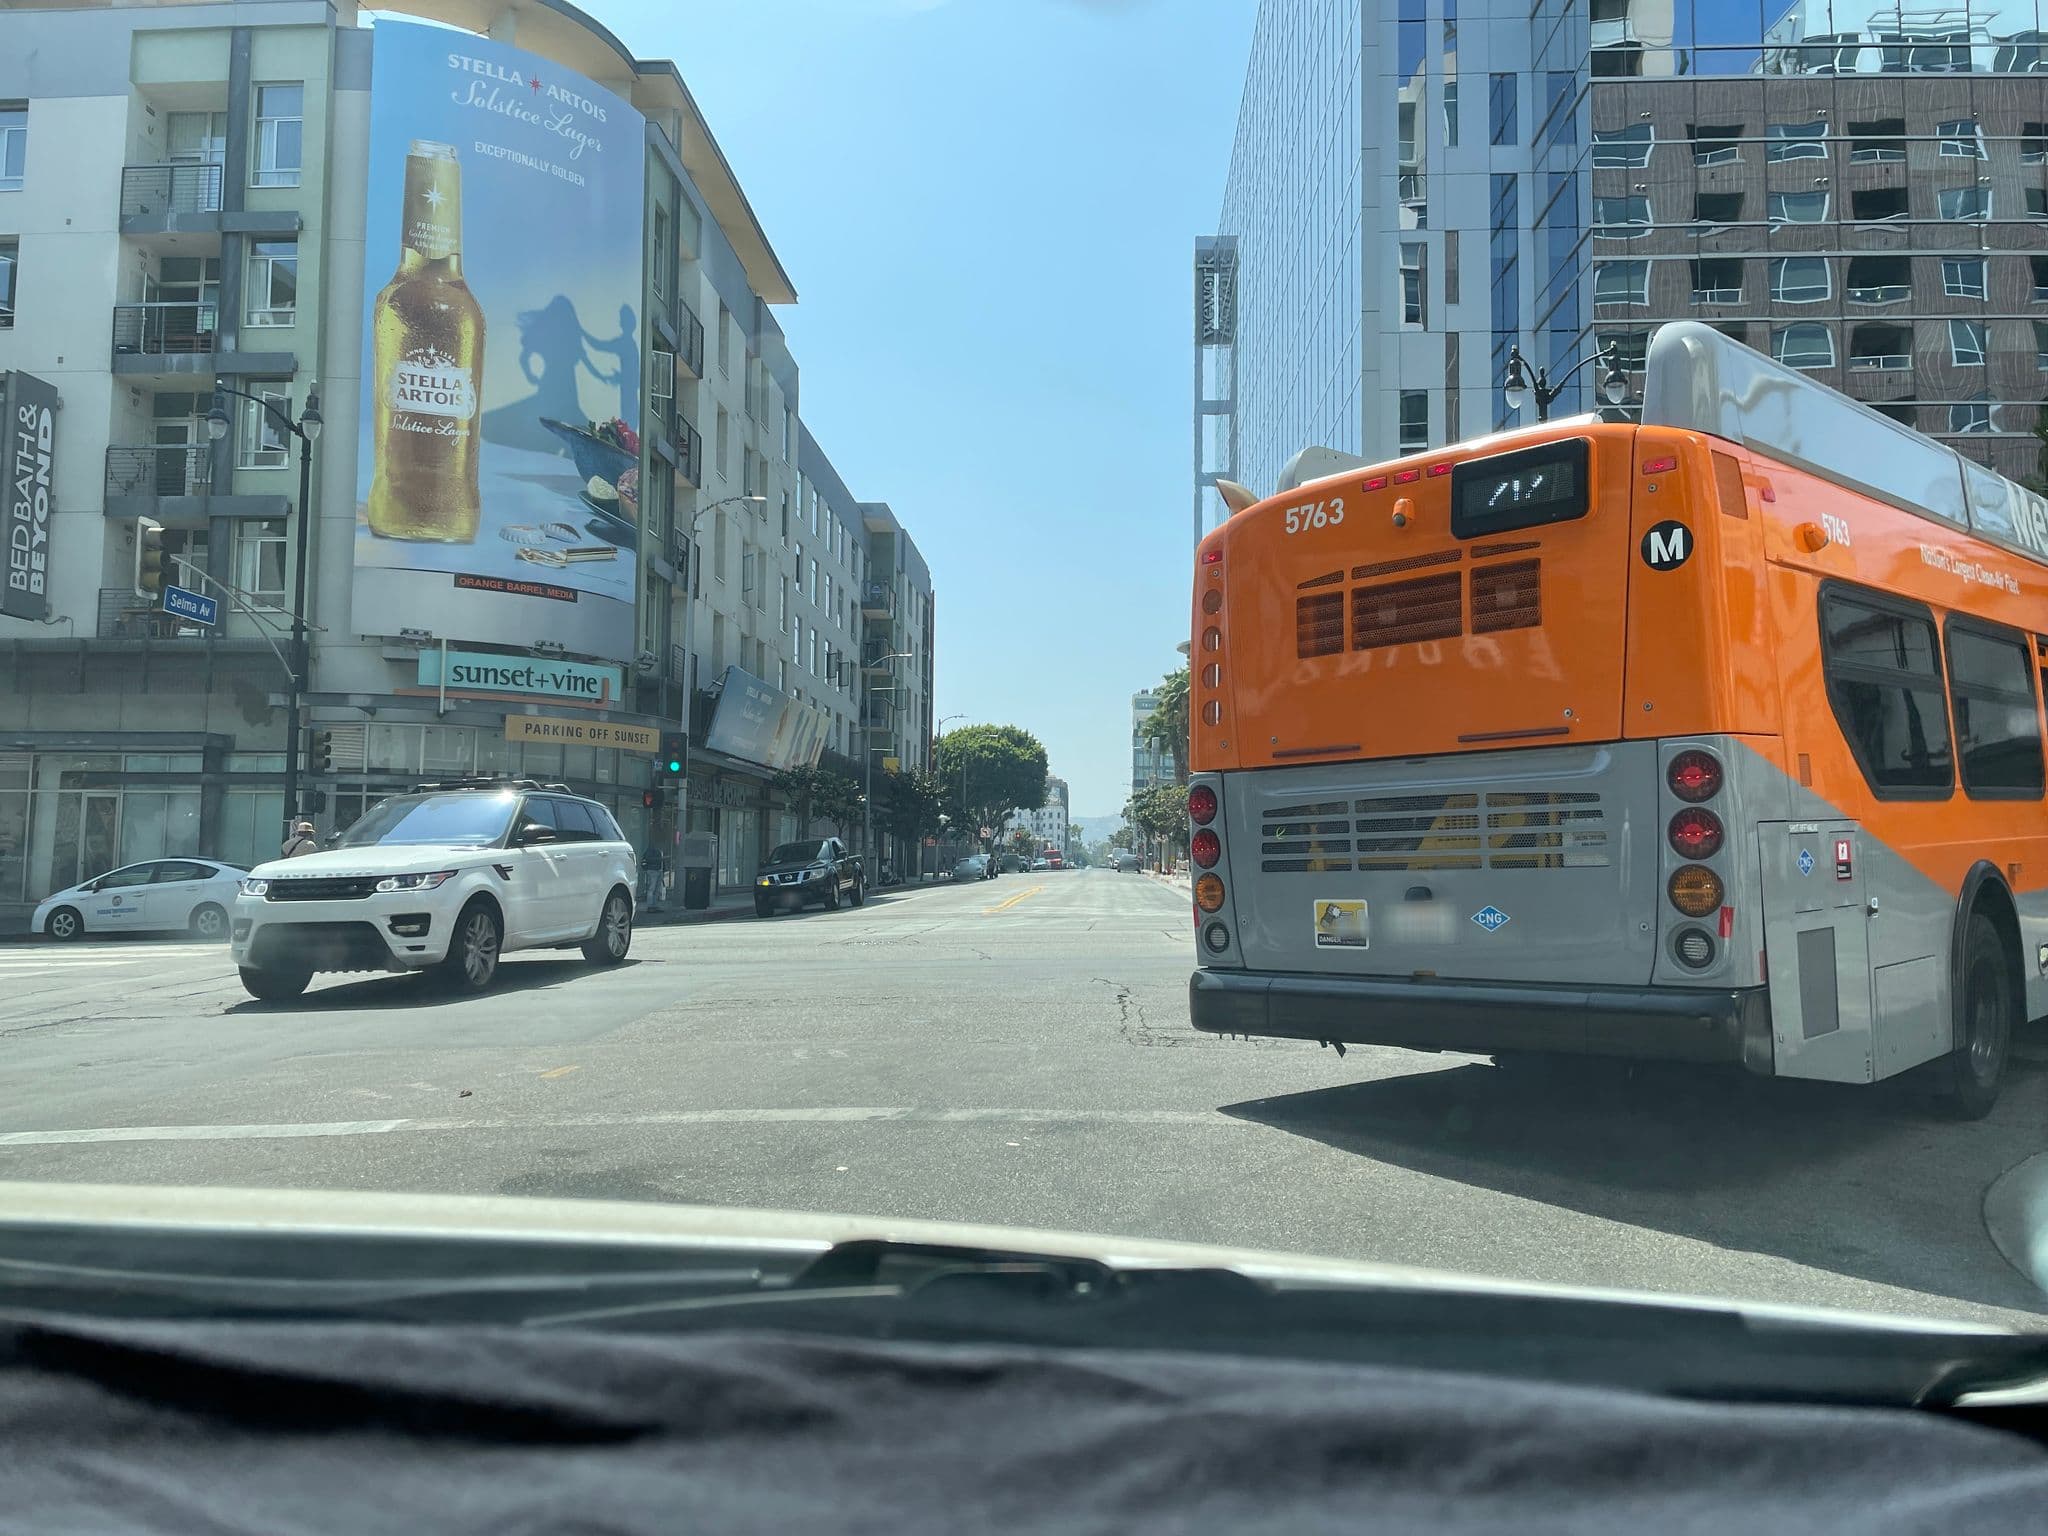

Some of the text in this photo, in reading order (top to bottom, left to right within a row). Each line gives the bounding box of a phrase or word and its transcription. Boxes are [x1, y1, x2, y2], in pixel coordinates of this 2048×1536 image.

[448, 54, 607, 122] STELLA ARTOIS
[451, 79, 606, 160] Solstice Lager
[474, 141, 585, 187] EXCEPTIONALLY GOLDEN
[1197, 255, 1215, 338] wework
[396, 387, 464, 407] ARTOIS
[398, 372, 463, 391] STELLA
[392, 414, 470, 446] Solstice Lager
[9, 403, 38, 591] BED BATH &
[30, 407, 52, 595] BEYOND
[1285, 498, 1345, 534] 5763
[1821, 512, 1850, 547] 5763
[2004, 479, 2048, 557] Me
[1650, 527, 1684, 564] M
[170, 593, 210, 617] Selma Av
[459, 577, 574, 600] ORANGE BARREL MEDIA
[452, 664, 597, 694] sunset+vine
[525, 722, 650, 744] PARKING OFF SUNSET
[1478, 912, 1503, 924] CNG
